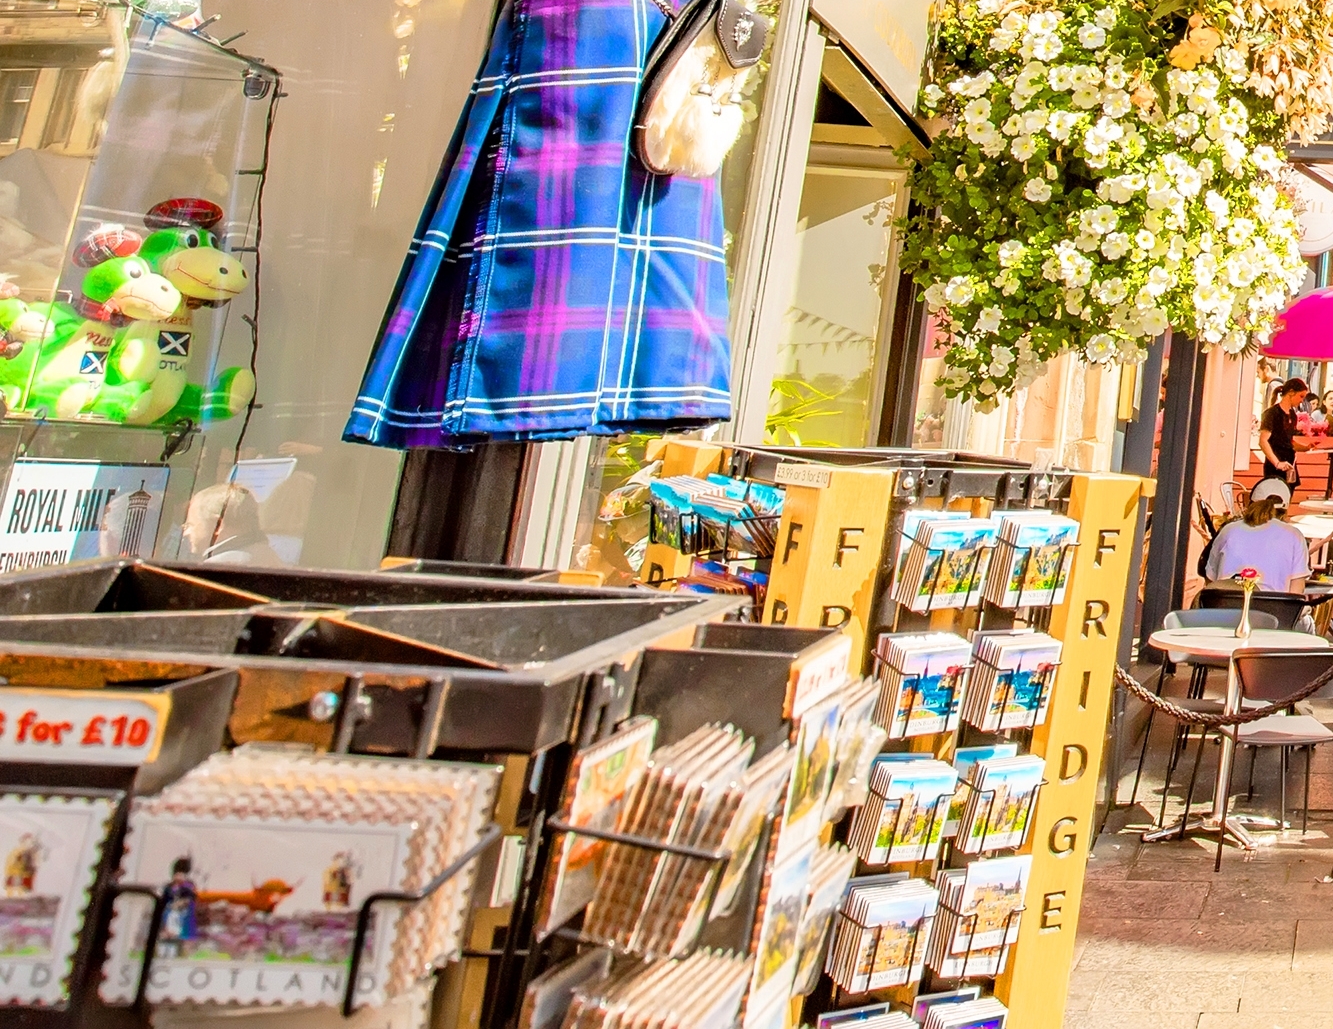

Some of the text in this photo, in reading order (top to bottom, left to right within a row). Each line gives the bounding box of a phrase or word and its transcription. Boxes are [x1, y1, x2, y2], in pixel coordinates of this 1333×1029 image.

[776, 466, 794, 480] £3.99
[806, 470, 816, 483] for
[815, 471, 828, 485] £10
[6, 488, 117, 534] ROYAL MILE
[16, 709, 151, 750] for £10
[1039, 527, 1121, 935] FRIDGE
[118, 966, 380, 996] SCOTLAND
